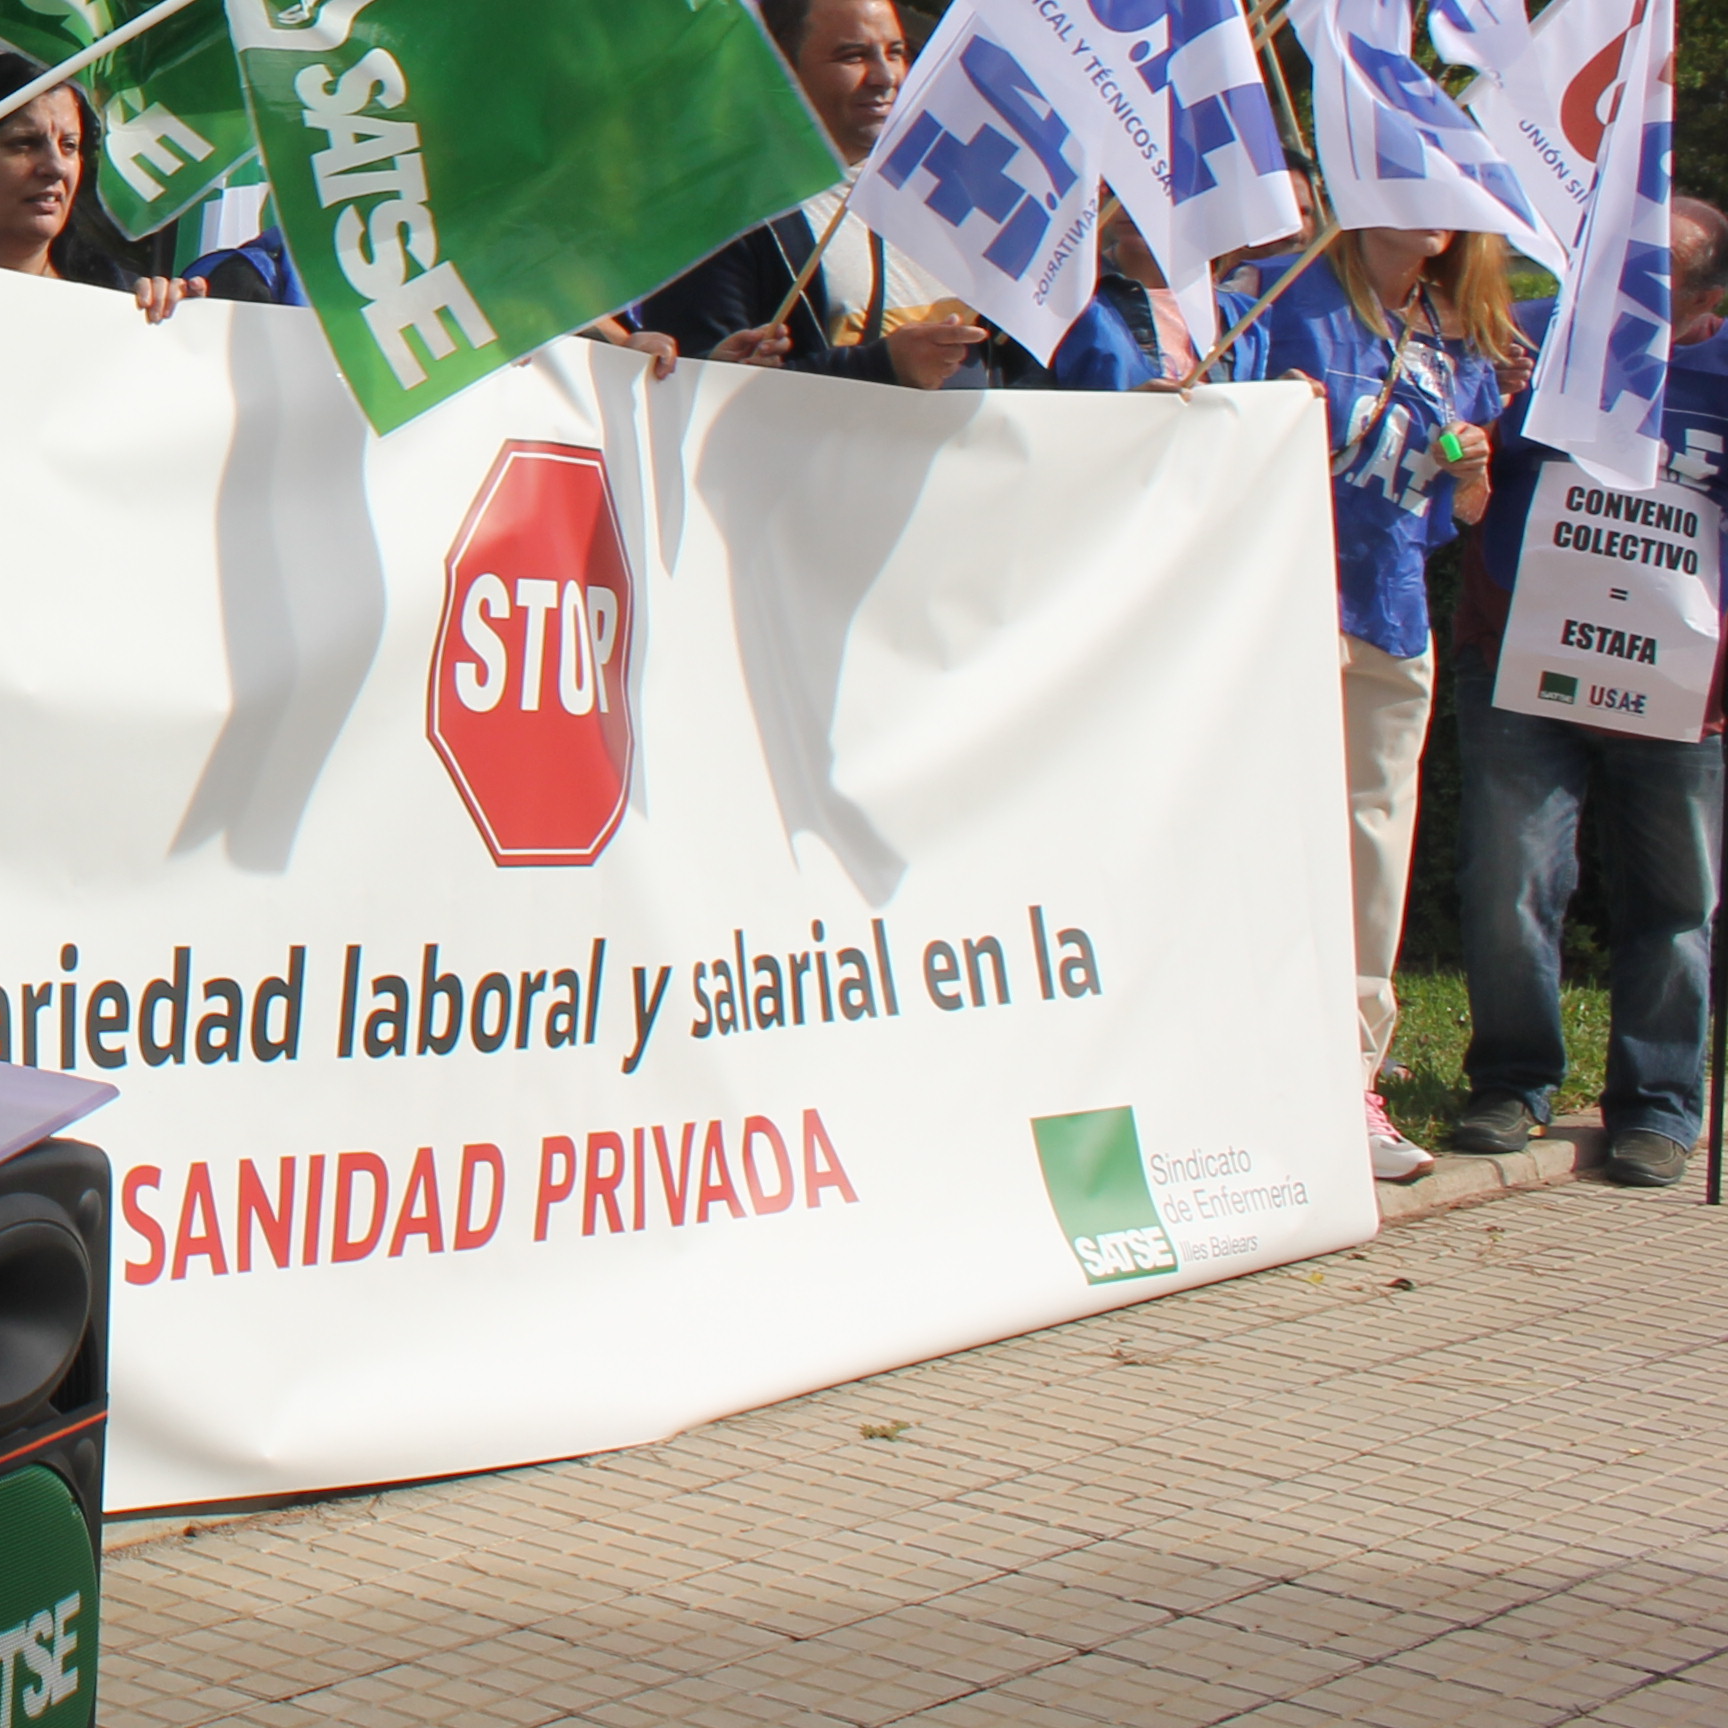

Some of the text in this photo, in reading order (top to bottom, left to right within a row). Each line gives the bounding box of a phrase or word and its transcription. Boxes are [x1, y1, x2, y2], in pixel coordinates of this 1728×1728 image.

[1072, 37, 1090, 57] Y
[1081, 55, 1159, 162] TÉCNICOS
[294, 46, 499, 392] SATSE
[1565, 485, 1699, 539] CONVENIO
[1553, 520, 1699, 576] COLECTIVO
[454, 572, 619, 716] STOP
[1560, 618, 1658, 665] ESTAFA
[336, 937, 607, 1060] laboral
[620, 965, 673, 1075] y
[690, 917, 901, 1040] salarial
[922, 934, 1012, 1012] en
[1027, 904, 1103, 1001] la
[1149, 1145, 1252, 1187] Sindicato
[121, 1108, 861, 1286] SANIDAD PRIVADA
[1162, 1175, 1309, 1225] de Enfermería
[1073, 1225, 1176, 1277] SATSE
[1210, 1233, 1259, 1258] Balears
